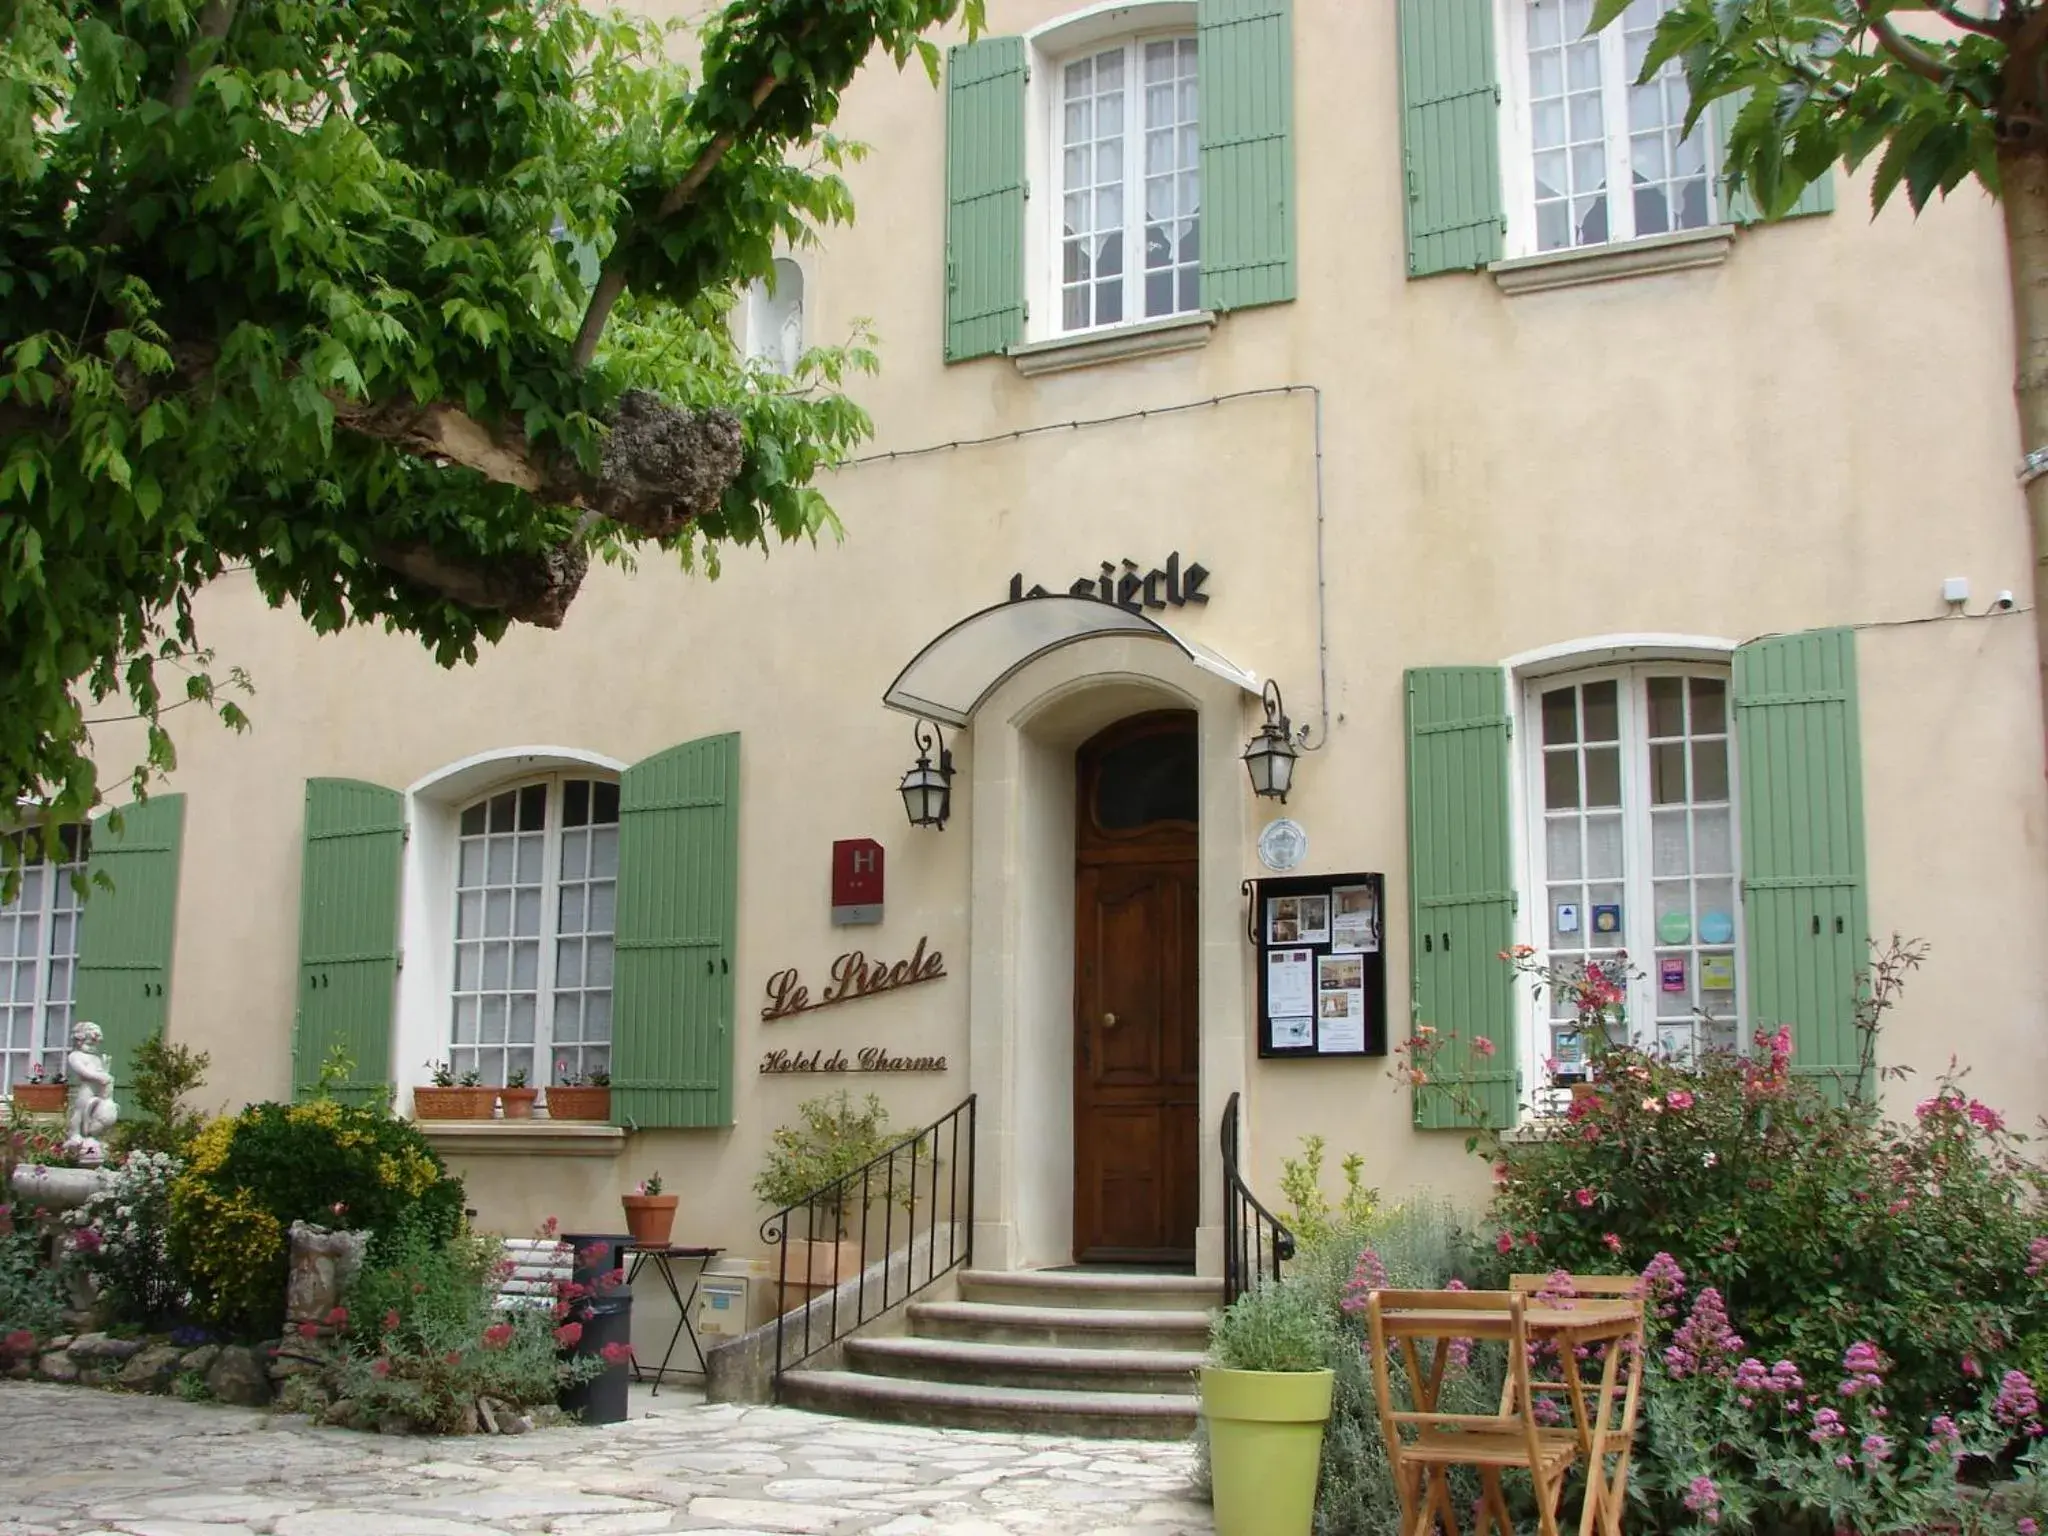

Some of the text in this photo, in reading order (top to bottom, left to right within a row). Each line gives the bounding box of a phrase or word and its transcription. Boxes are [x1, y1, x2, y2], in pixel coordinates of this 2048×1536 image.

[854, 850, 874, 873] H
[761, 936, 944, 1017] Le Siècle
[824, 1049, 849, 1071] de
[857, 1047, 947, 1072] Charme
